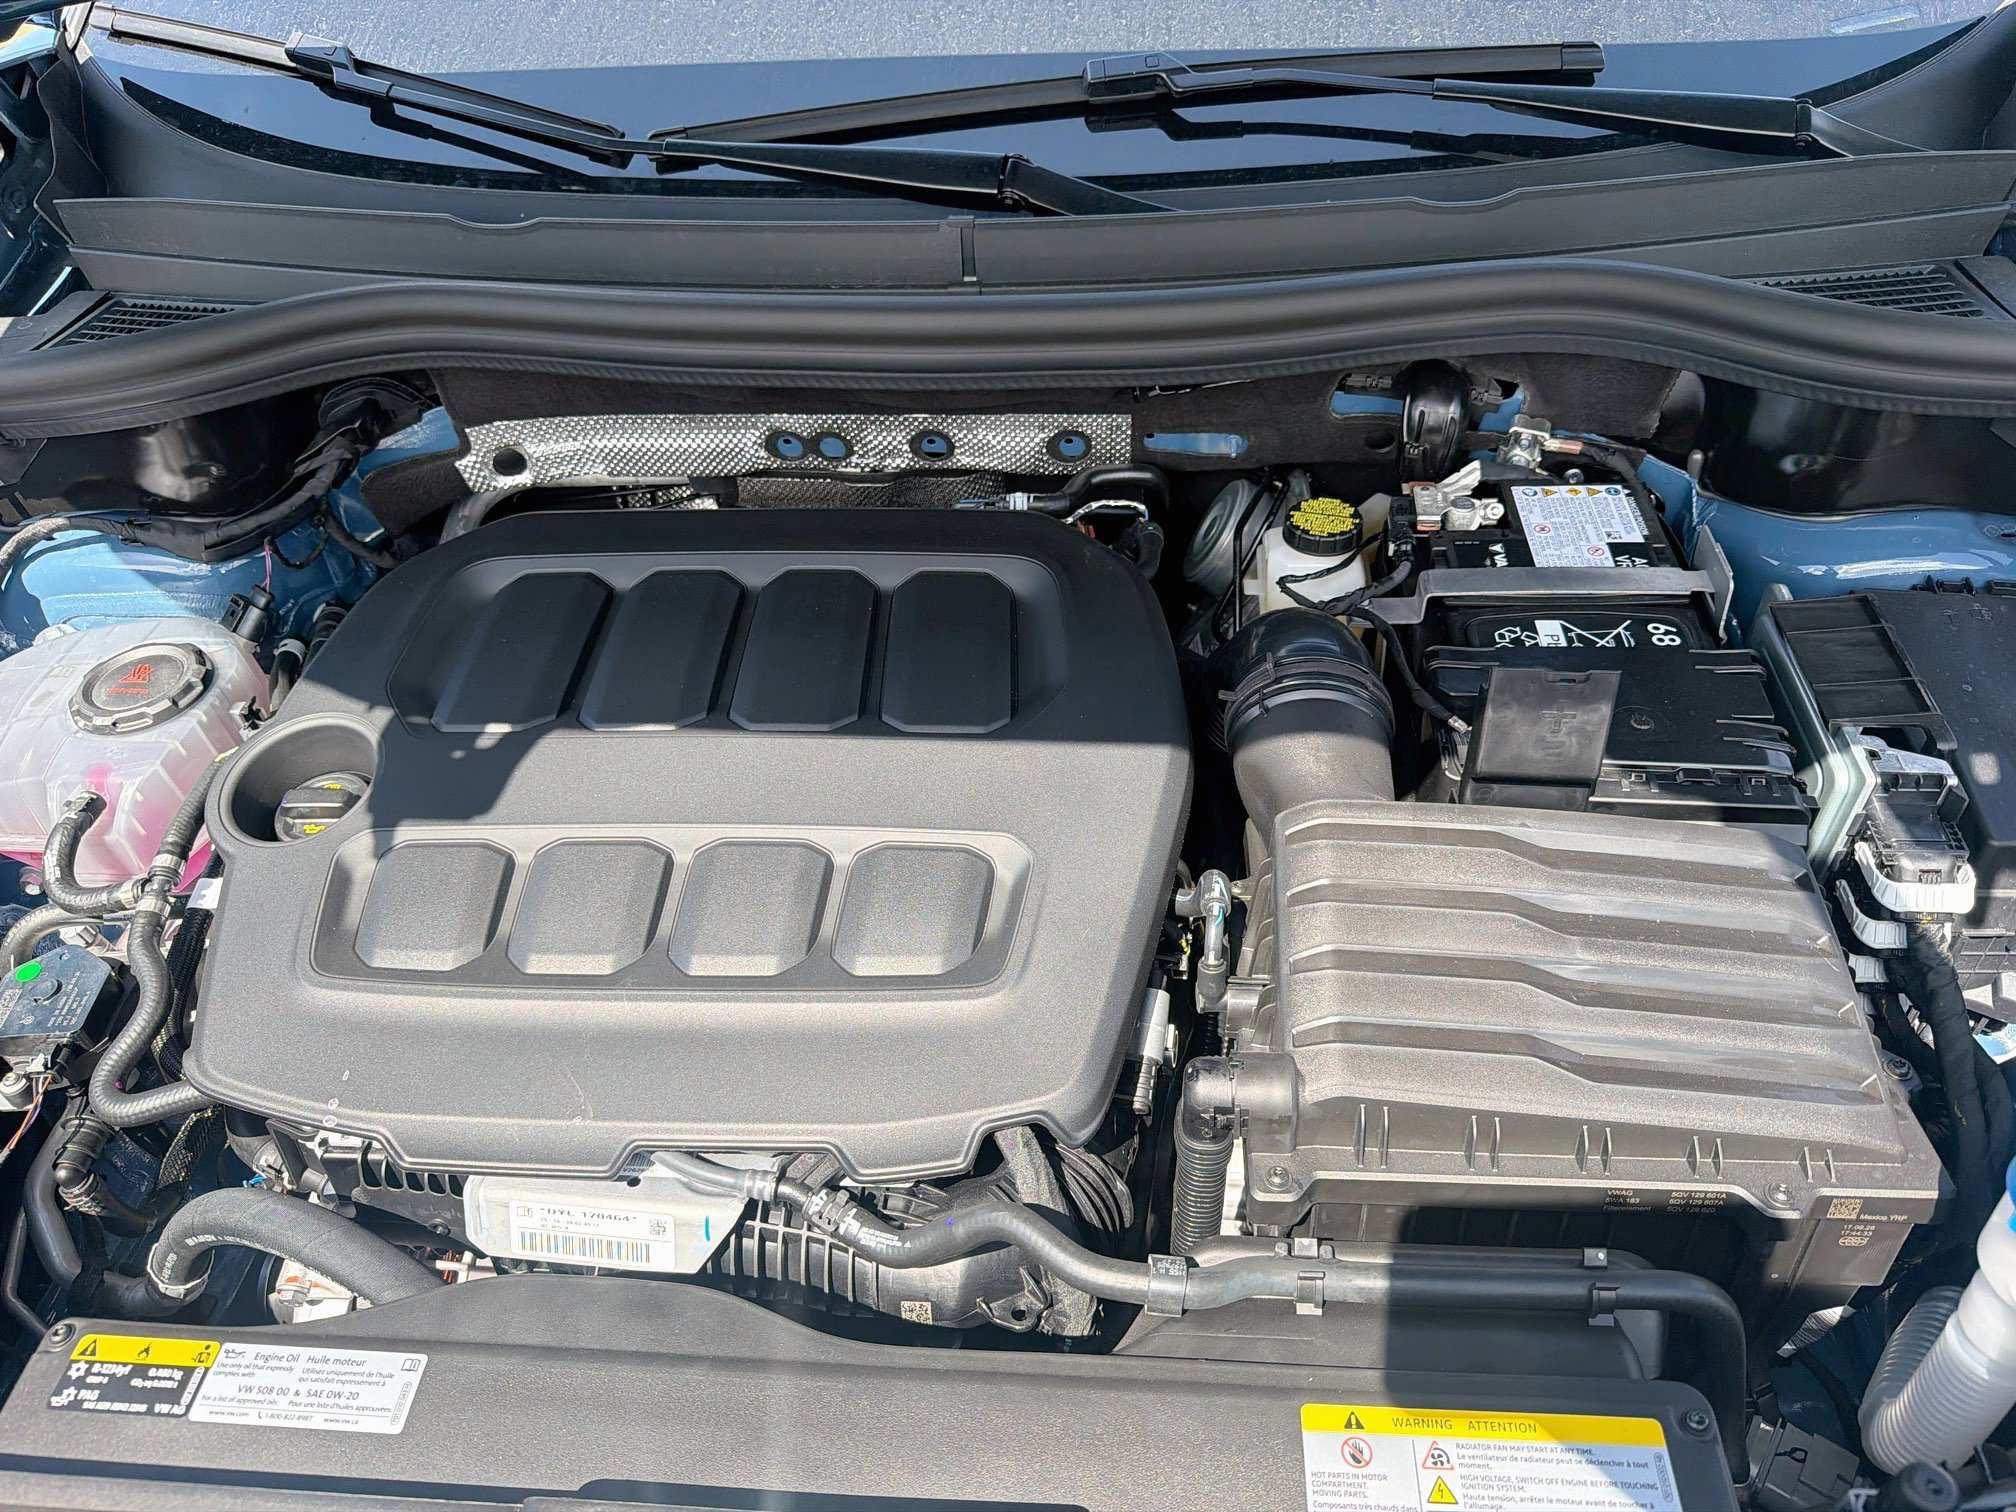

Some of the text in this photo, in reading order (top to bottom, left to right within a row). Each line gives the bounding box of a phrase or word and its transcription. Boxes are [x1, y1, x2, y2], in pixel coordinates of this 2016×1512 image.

[254, 1352, 300, 1363] Engine Oil
[306, 1355, 366, 1366] Huile moteur
[266, 1365, 294, 1373] expressly
[326, 1369, 365, 1378] uniquement
[336, 1379, 380, 1387] expressément
[238, 1385, 255, 1394] VW
[256, 1386, 275, 1394] 508
[276, 1387, 290, 1396] 00
[306, 1389, 325, 1398] SAE
[326, 1390, 360, 1400] 0W-20
[330, 1402, 354, 1410] d'huiles
[1392, 1418, 1537, 1433] WARNING ATTENTION
[1456, 1443, 1492, 1451] RADIATOR
[1526, 1445, 1548, 1453] START
[1467, 1453, 1507, 1461] ventilateur
[1520, 1455, 1554, 1464] radiateur
[1585, 1459, 1625, 1467] déclencher
[1328, 1472, 1350, 1480] PARTS
[1311, 1480, 1369, 1489] COMPARTMENT.
[1461, 1483, 1526, 1492] IGNITION SYSTEM.
[1480, 1476, 1514, 1484] VOLTAGE,
[1515, 1477, 1543, 1485] SWITCH
[1620, 1482, 1658, 1490] TOUCHING
[1312, 1489, 1342, 1498] MOVING
[1313, 1500, 1358, 1511] Composants
[1359, 1503, 1372, 1511] très
[1374, 1503, 1399, 1512] chauds
[1464, 1501, 1506, 1511] l'allumage.
[1487, 1494, 1518, 1503] tension,
[1519, 1495, 1544, 1503] arrêter
[1547, 1496, 1554, 1504] le
[1556, 1498, 1583, 1506] moteur
[1585, 1499, 1605, 1507] avant
[1608, 1500, 1617, 1508] de
[1620, 1501, 1647, 1509] toucher
